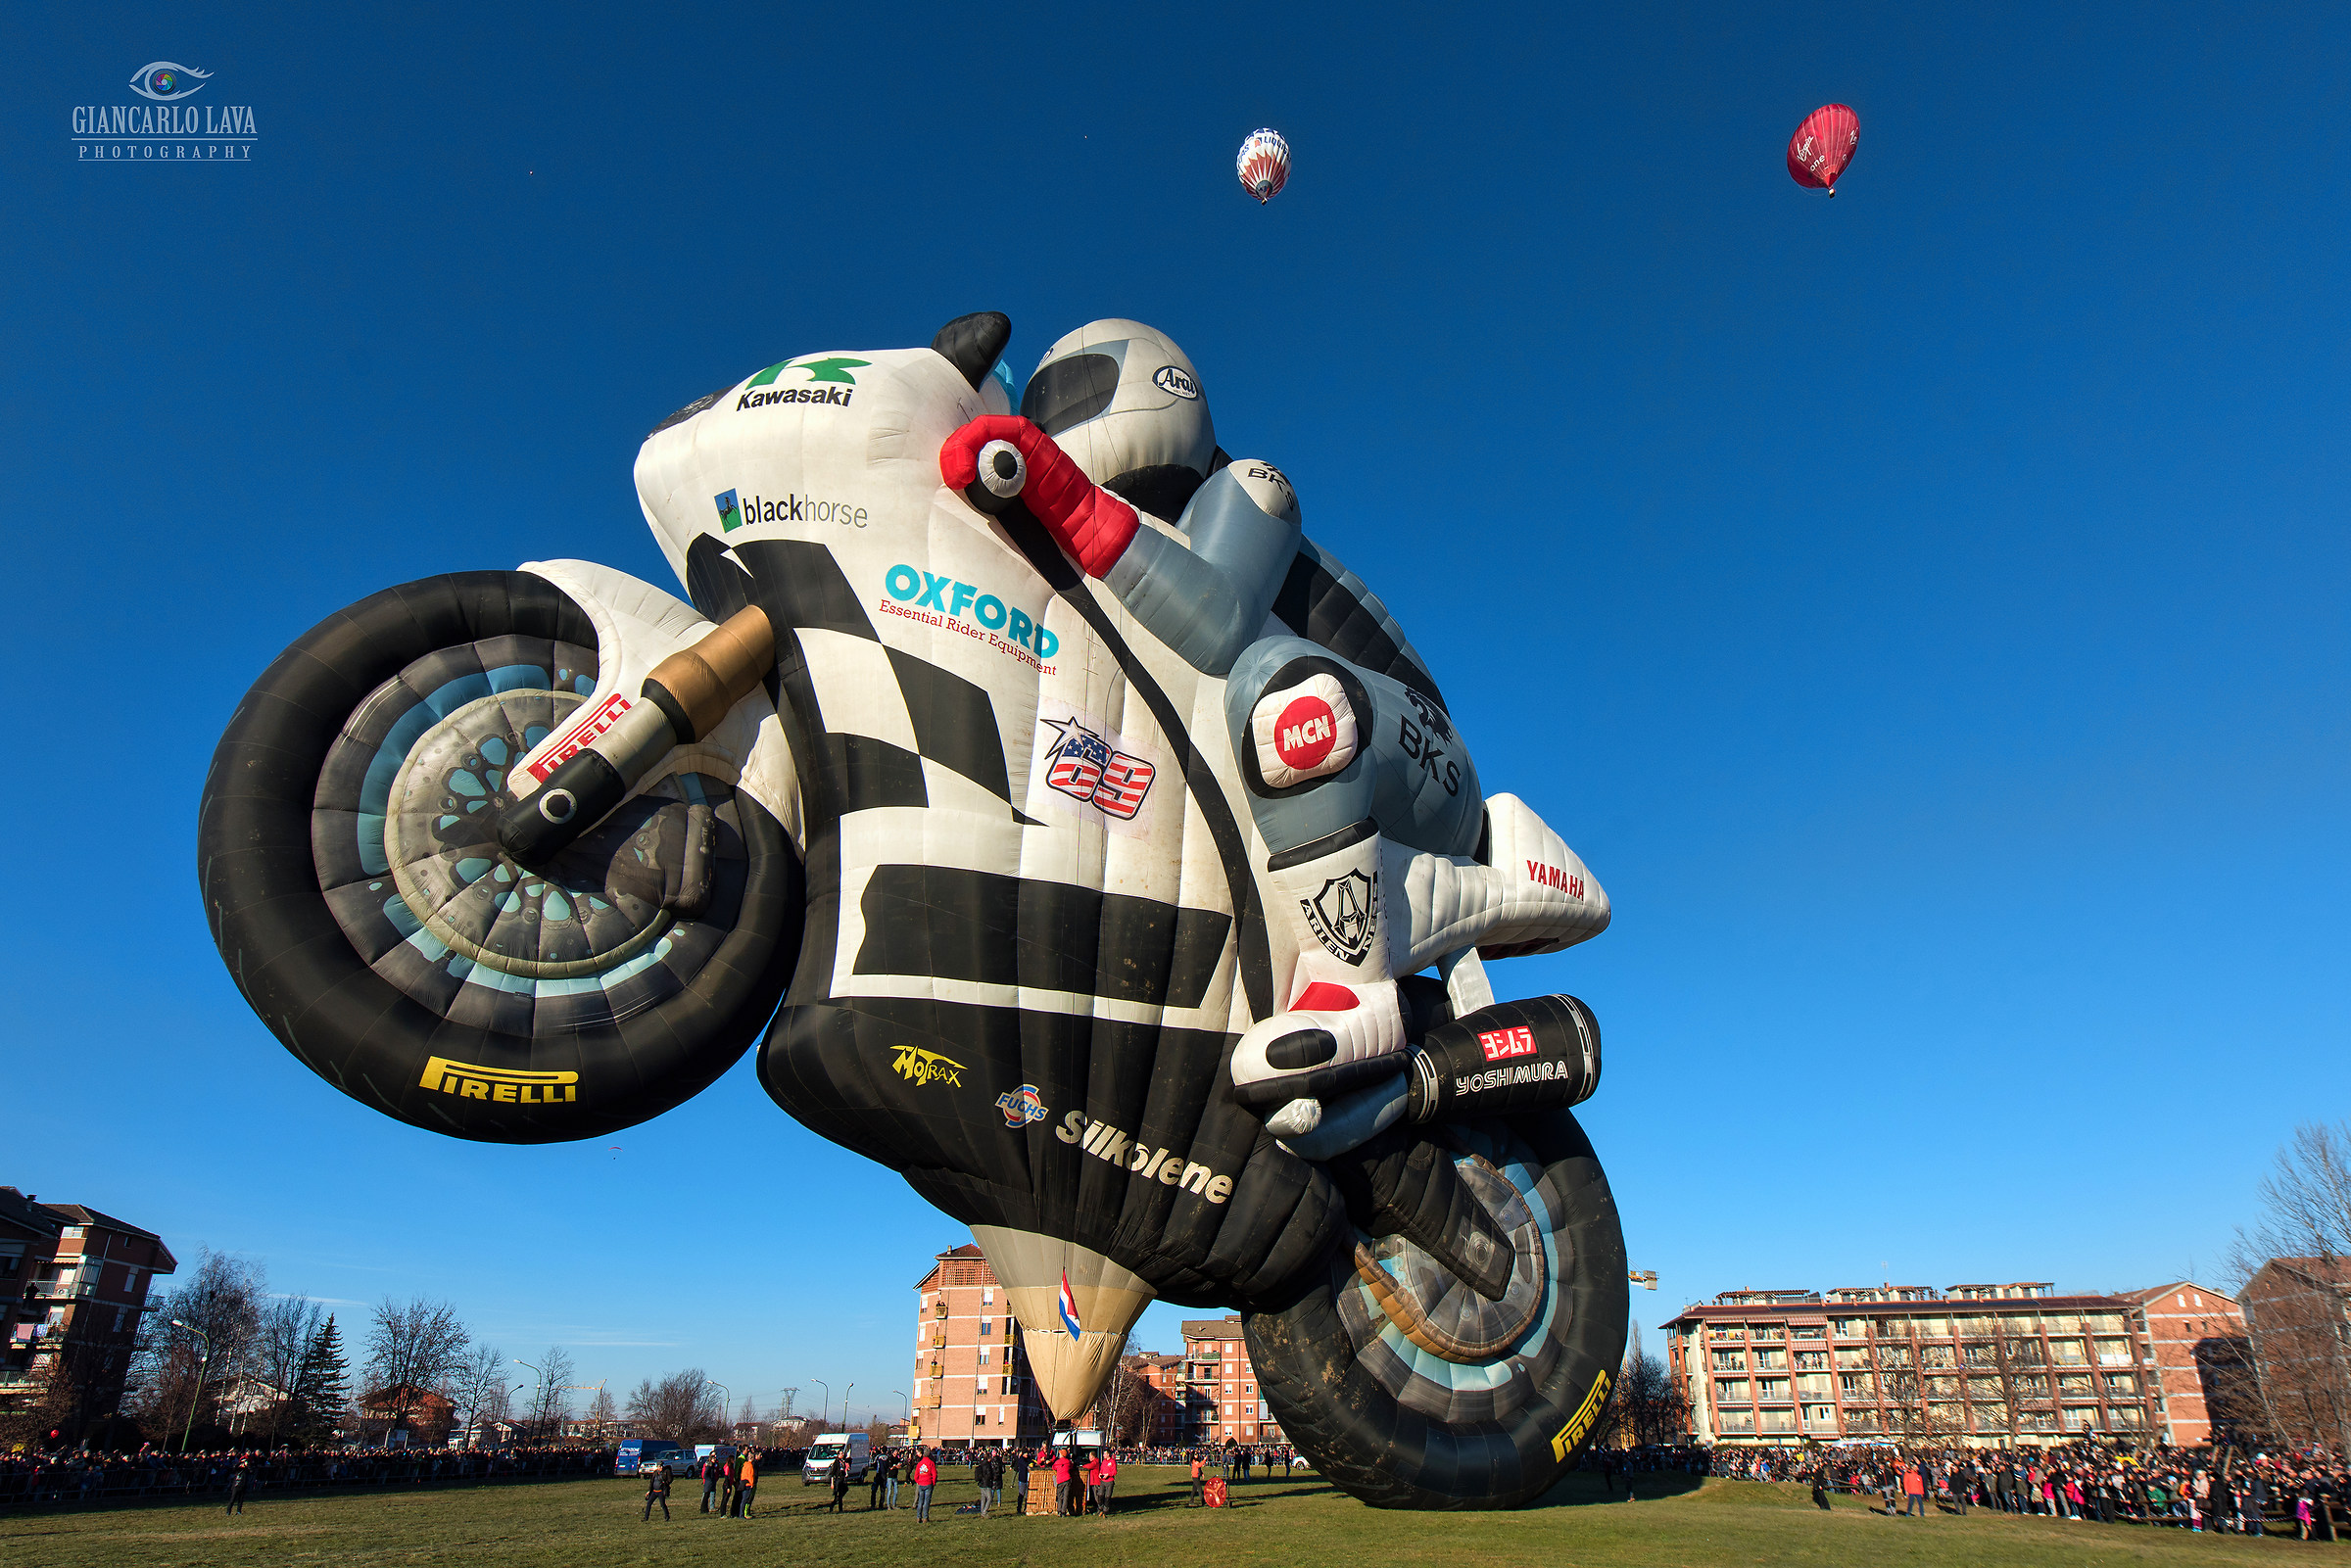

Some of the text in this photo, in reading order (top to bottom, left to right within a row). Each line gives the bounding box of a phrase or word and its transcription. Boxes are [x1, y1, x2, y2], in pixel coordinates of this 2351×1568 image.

[1809, 155, 1825, 171] one
[736, 386, 853, 411] Kawasaki
[1158, 368, 1196, 395] Arai
[1247, 467, 1294, 511] BKS
[743, 493, 868, 529] blackhorse
[885, 564, 1060, 658] OXFORD
[879, 599, 1058, 676] Essential Rider Equipment
[1282, 714, 1331, 752] MCN
[1045, 730, 1157, 821] 69
[1398, 713, 1462, 798] BKS
[1526, 859, 1585, 902] YAMAHA
[1301, 902, 1351, 962] ARLEN
[1480, 1027, 1533, 1059] ヨシムラ
[418, 1055, 580, 1104] PIRELLI
[1455, 1060, 1569, 1096] YOSHIMURA
[997, 1094, 1047, 1119] FUCHS
[1055, 1110, 1234, 1205] Silkolene
[1551, 1369, 1612, 1464] PIRELLI
